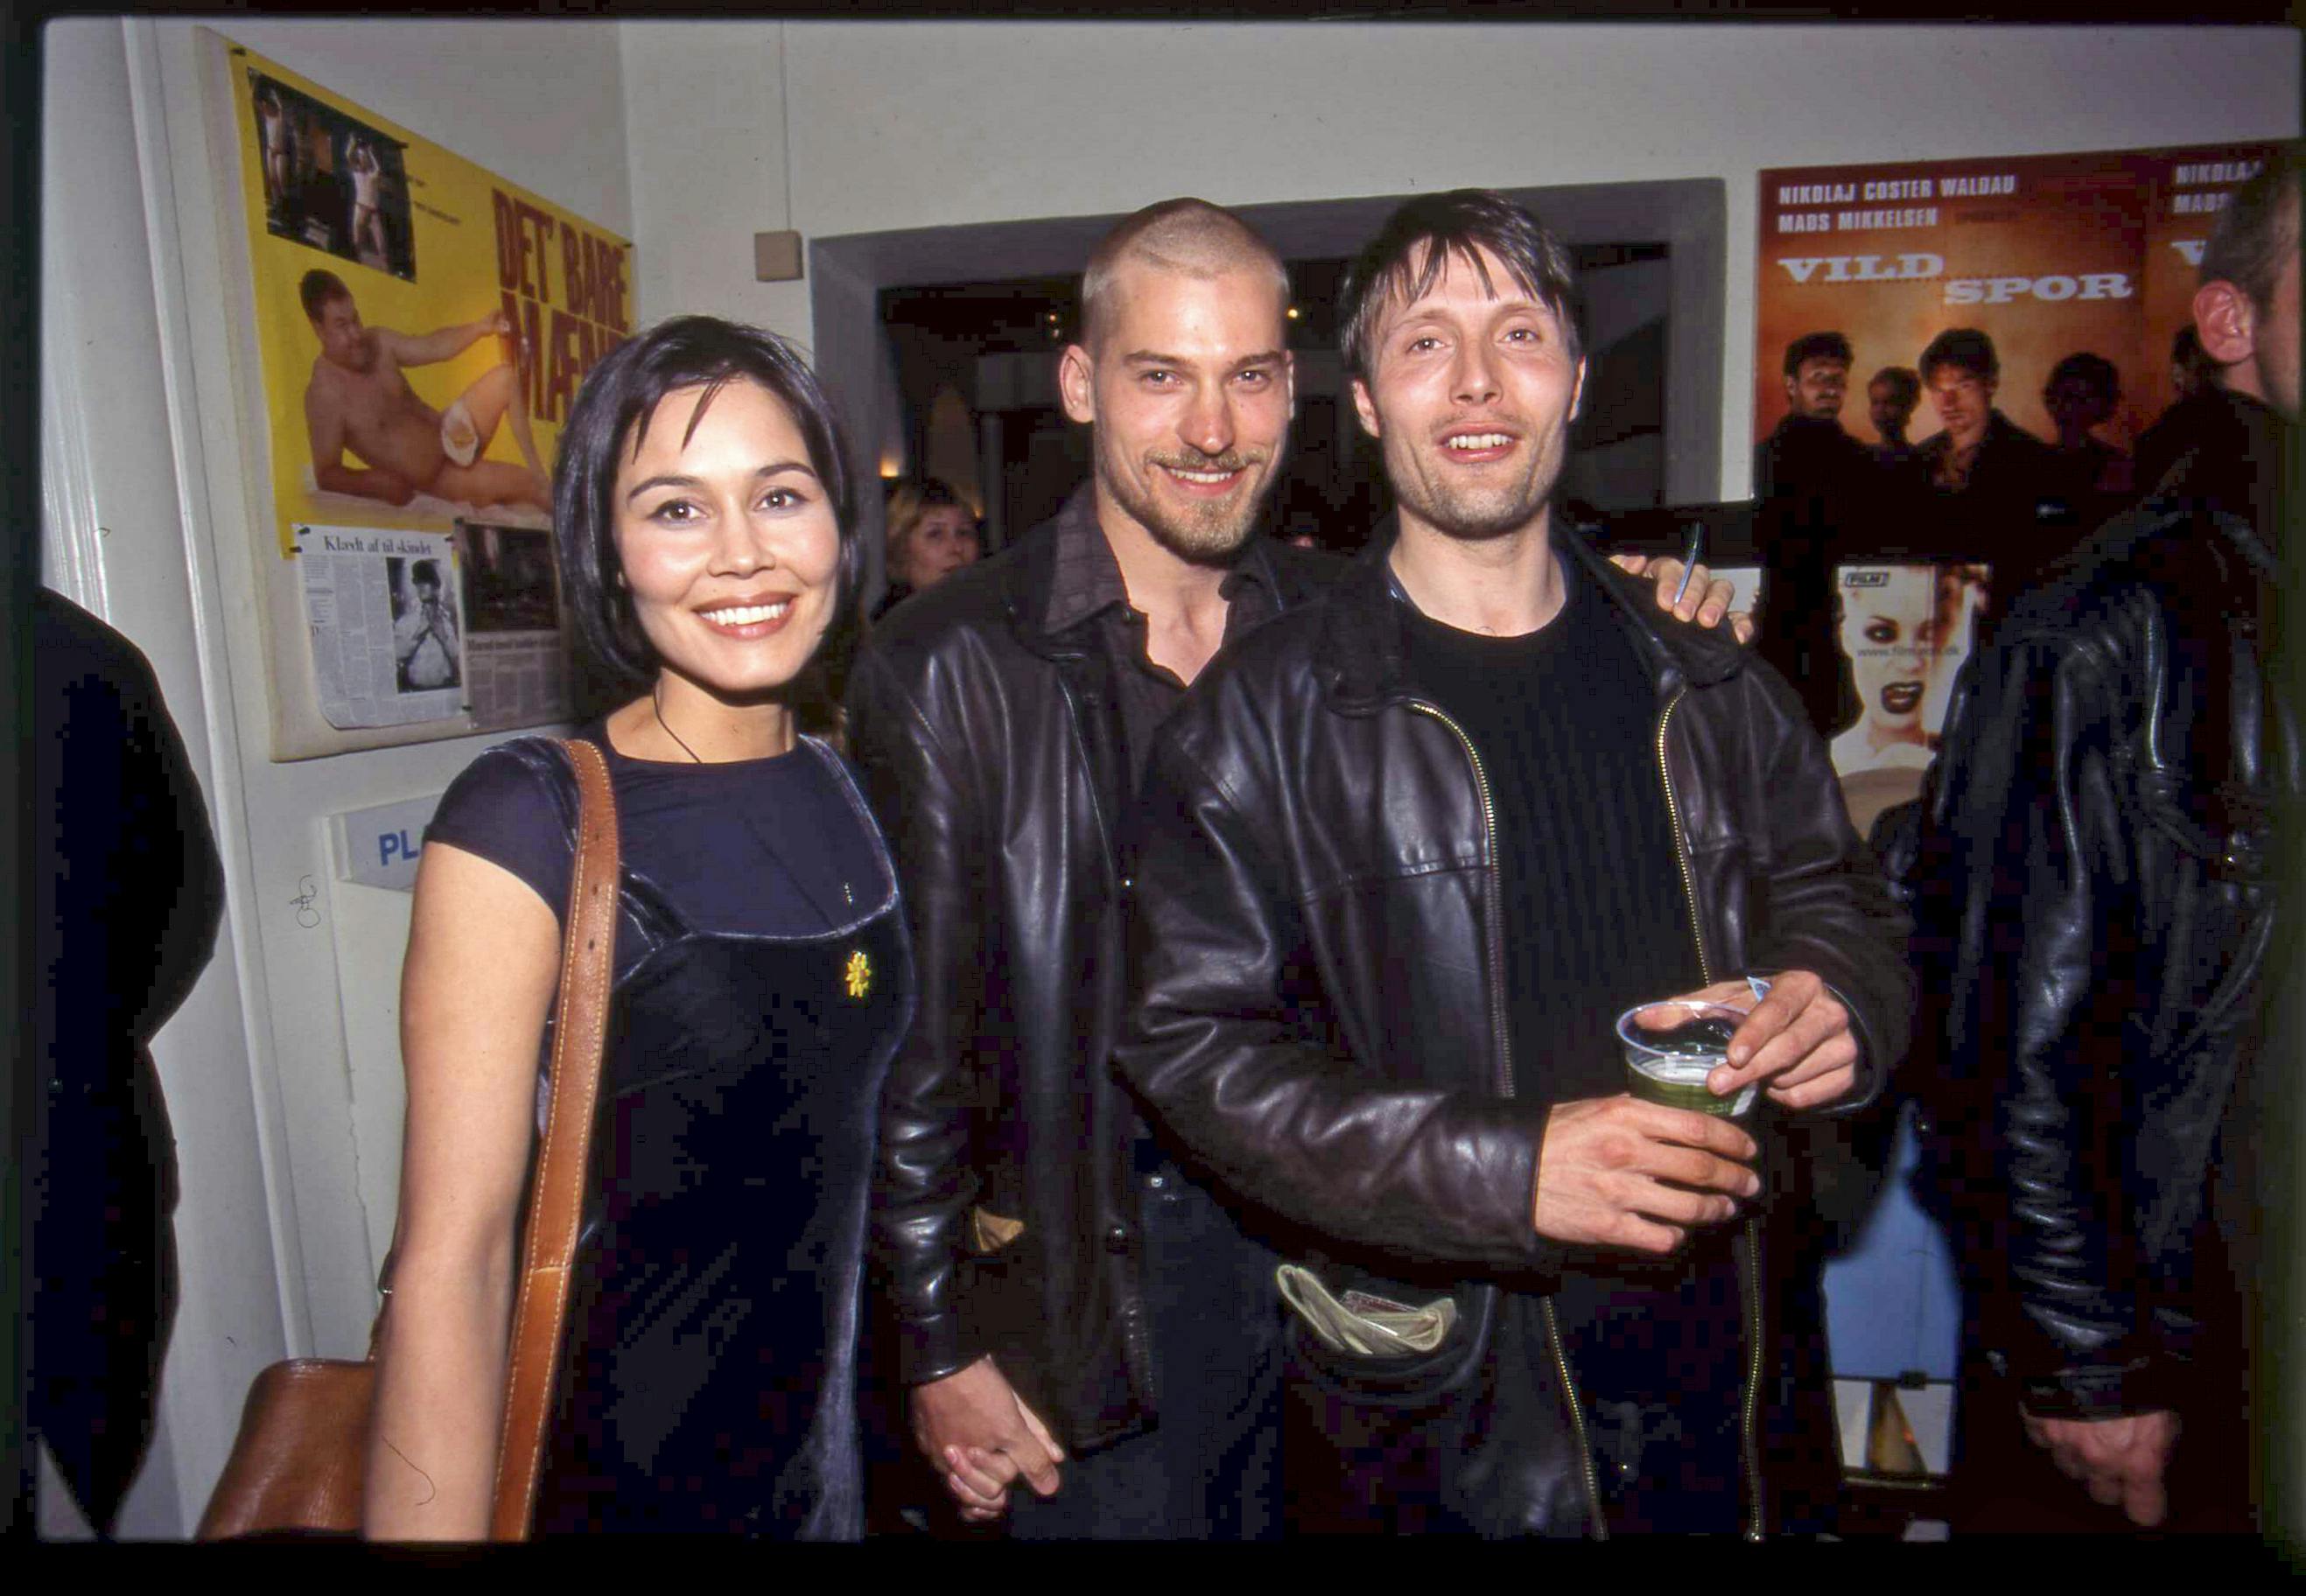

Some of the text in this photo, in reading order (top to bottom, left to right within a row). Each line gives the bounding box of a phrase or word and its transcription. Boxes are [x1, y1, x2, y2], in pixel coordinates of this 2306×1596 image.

[1779, 175, 2015, 205] NIKOLAJ COSTER WALDAU
[1778, 213, 1830, 234] MADS
[1838, 208, 1938, 230] MIKKELSEN
[560, 221, 629, 334] BARE
[1777, 253, 1945, 284] VILD
[1944, 273, 2134, 304] SPOR
[368, 538, 380, 553] af
[382, 539, 394, 553] til
